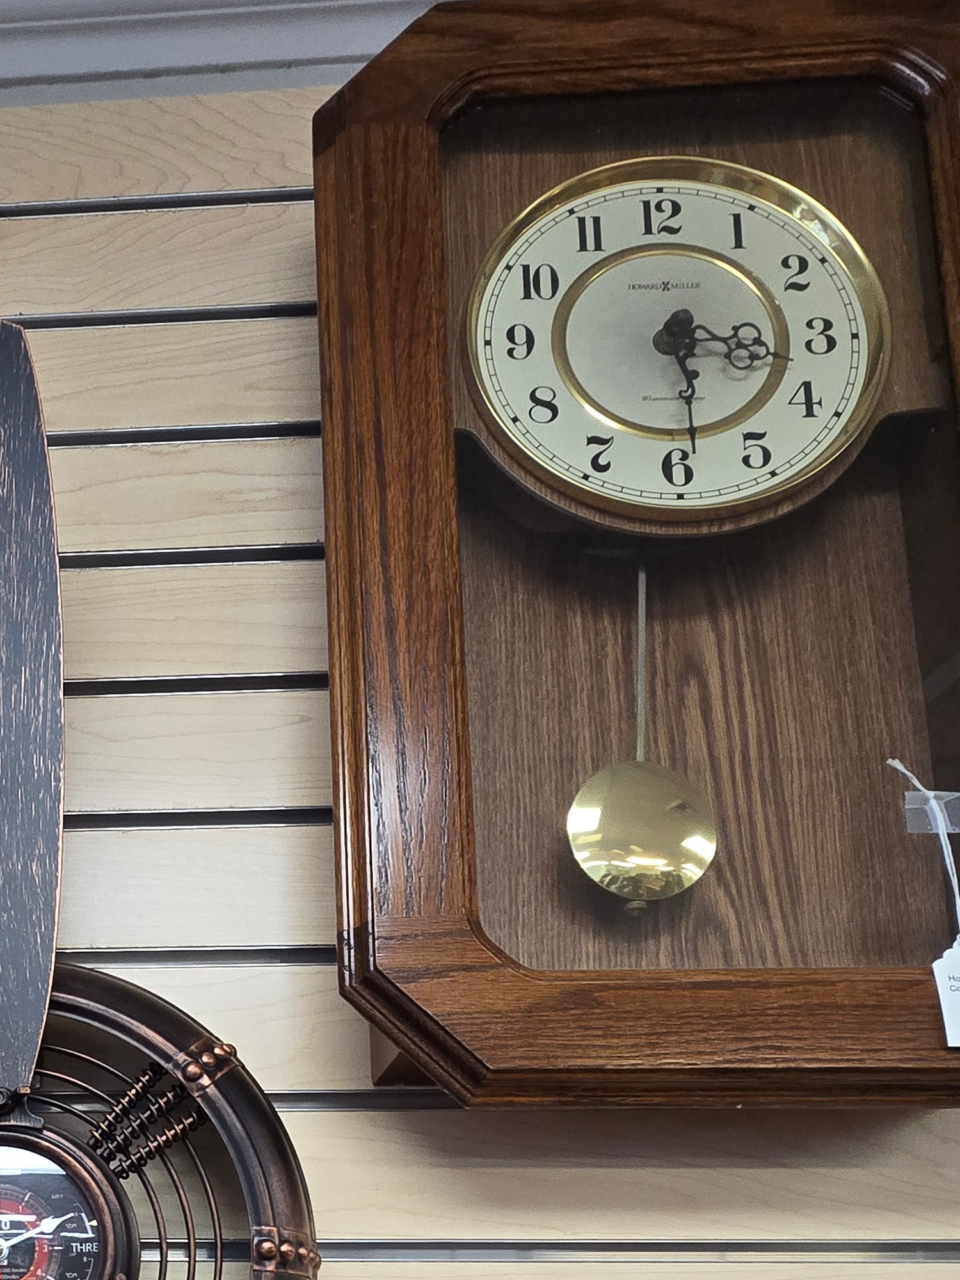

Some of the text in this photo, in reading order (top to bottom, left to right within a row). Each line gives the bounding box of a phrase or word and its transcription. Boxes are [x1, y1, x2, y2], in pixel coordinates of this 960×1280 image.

[576, 216, 605, 252] 11
[640, 199, 683, 236] 12
[729, 213, 747, 249] 1
[520, 263, 559, 300] 10
[780, 254, 811, 292] 2
[505, 323, 535, 360] 9
[804, 317, 837, 355] 3
[528, 386, 559, 424] 8
[787, 381, 823, 418] 4
[586, 435, 614, 474] 7
[661, 448, 694, 487] 6
[741, 431, 772, 469] 5
